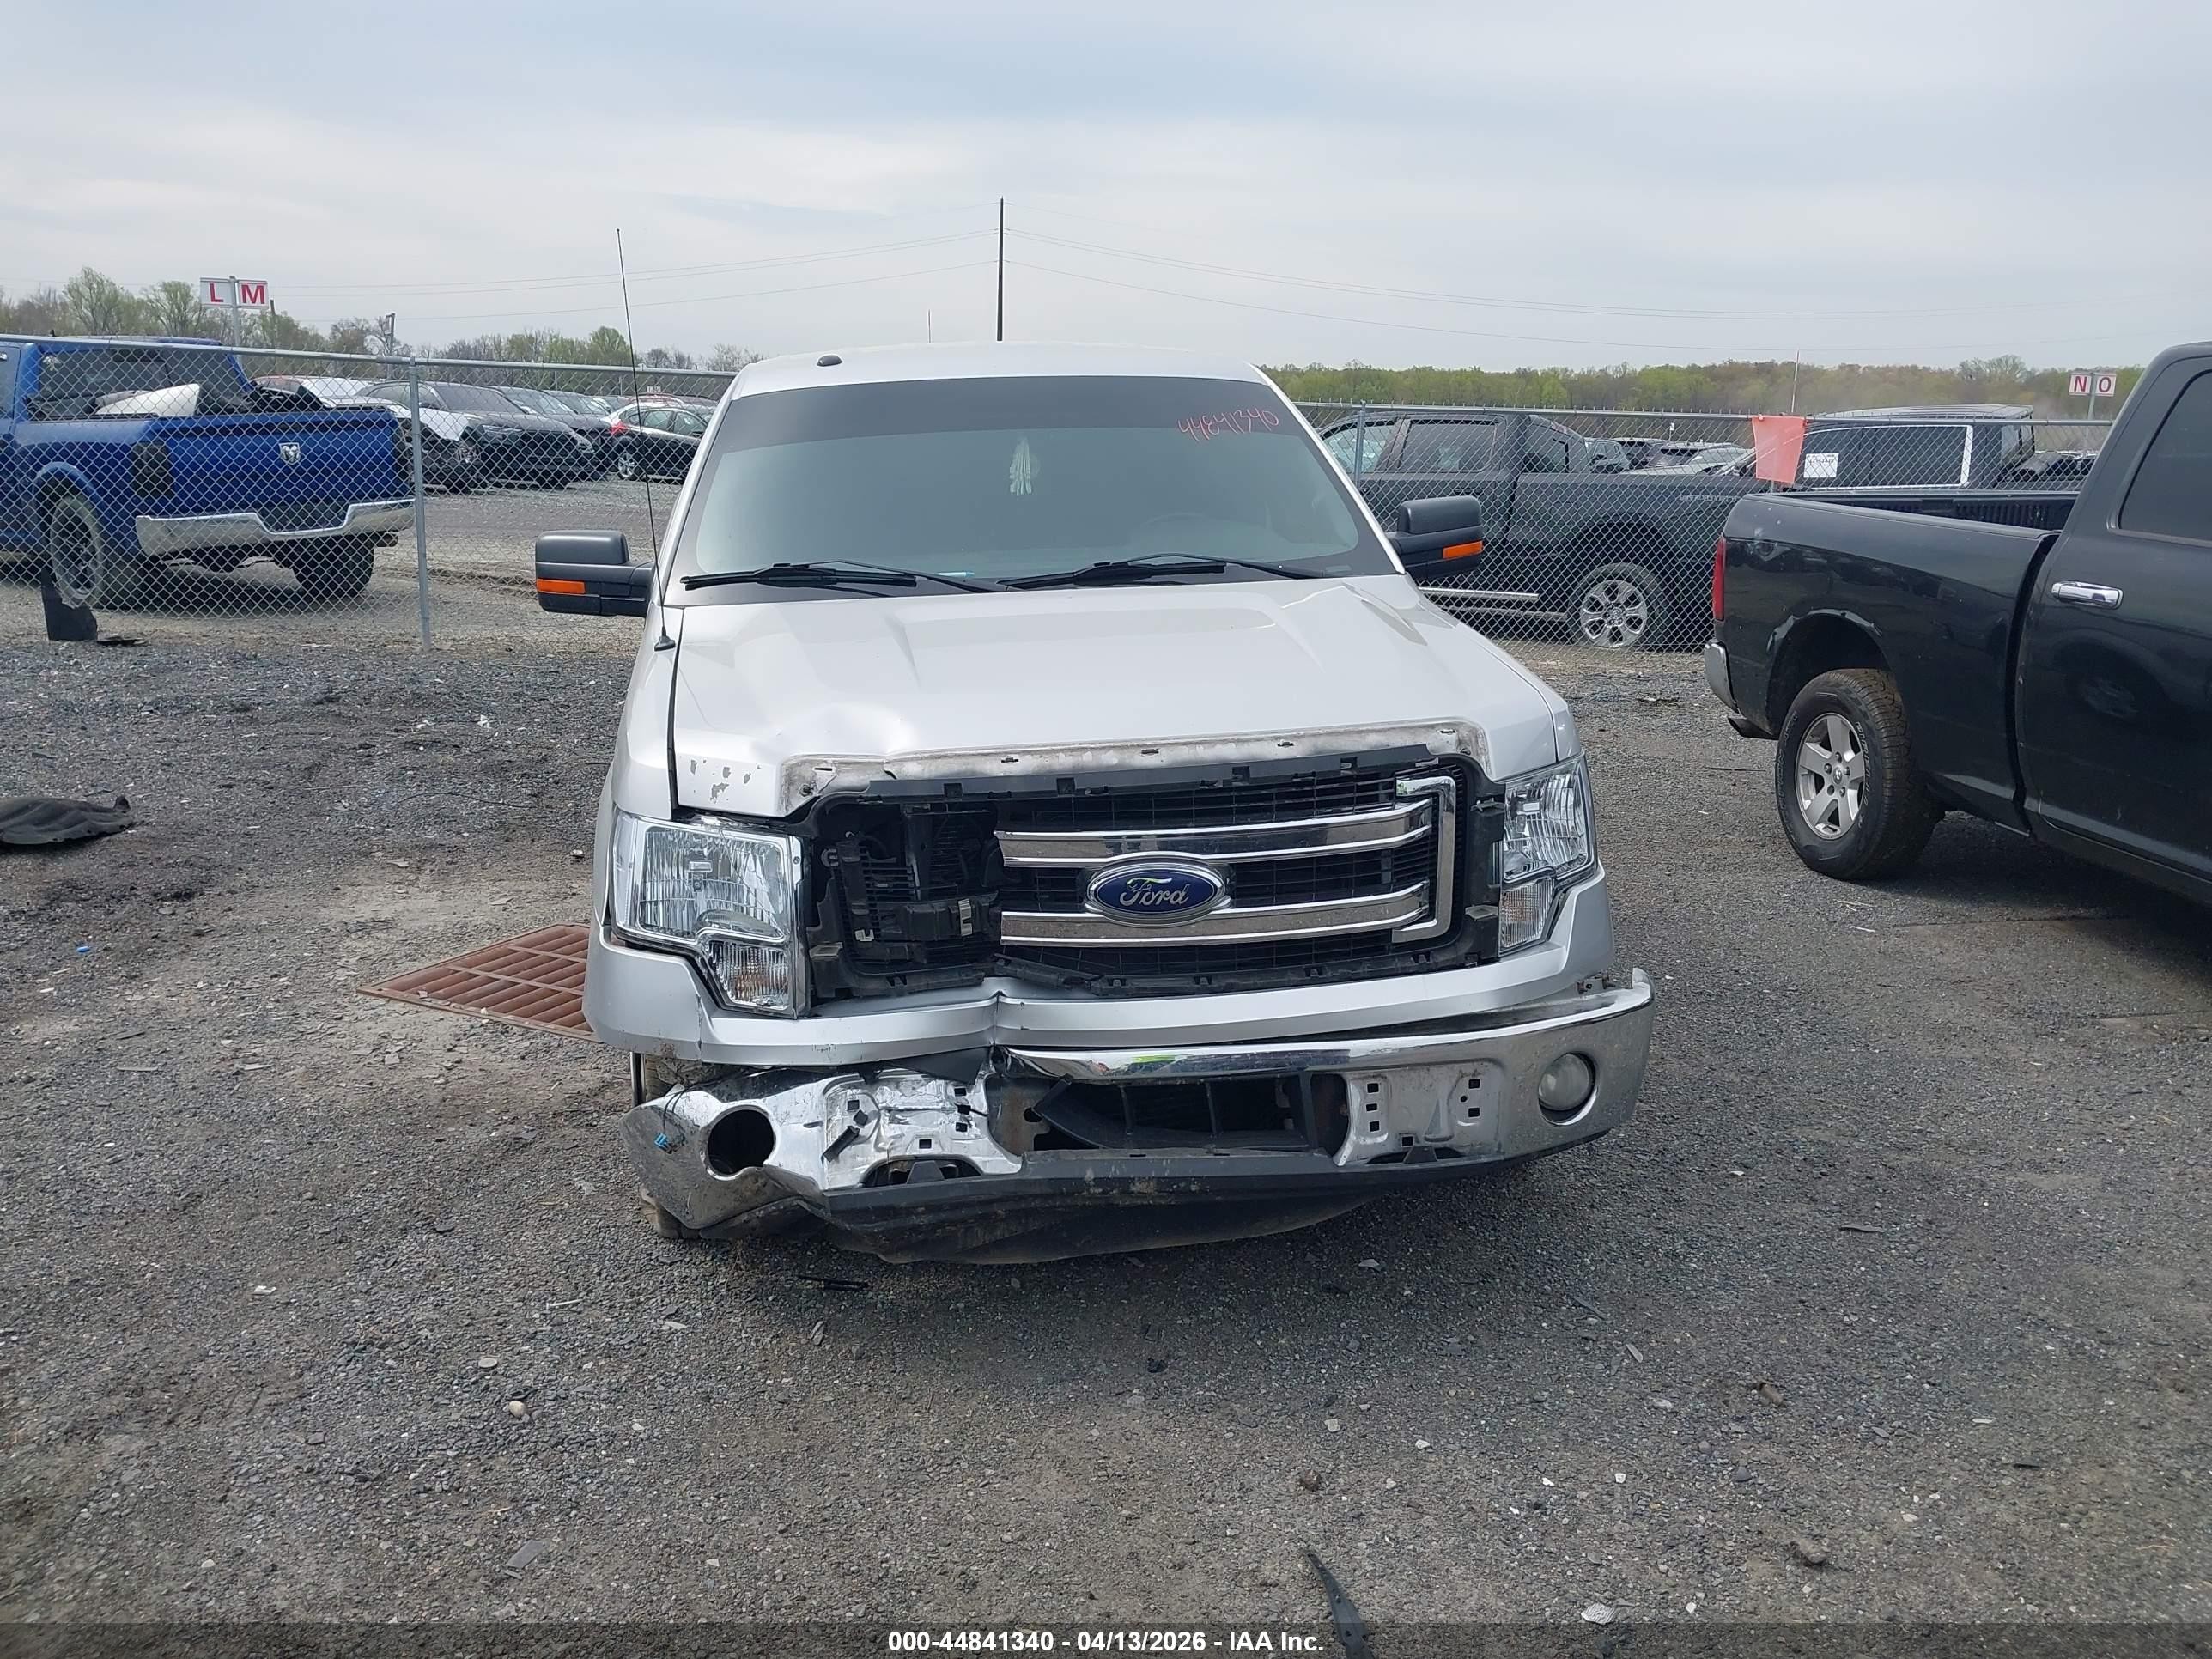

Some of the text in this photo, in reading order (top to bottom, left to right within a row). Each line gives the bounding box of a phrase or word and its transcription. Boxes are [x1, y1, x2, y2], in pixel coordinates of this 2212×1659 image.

[210, 283, 265, 304] L M
[2074, 375, 2112, 392] N O
[1119, 877, 1191, 906] Ford
